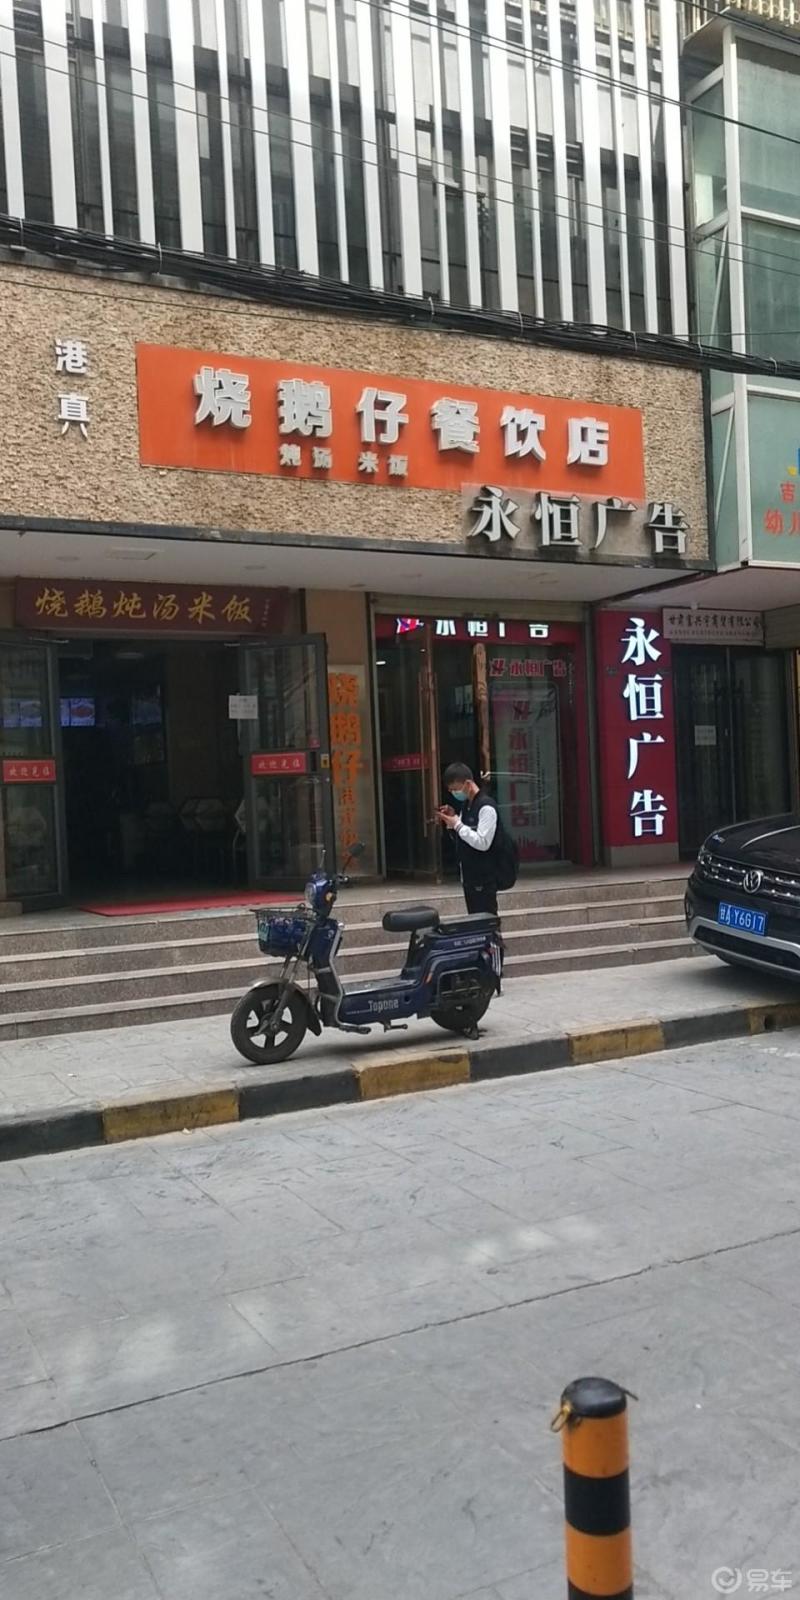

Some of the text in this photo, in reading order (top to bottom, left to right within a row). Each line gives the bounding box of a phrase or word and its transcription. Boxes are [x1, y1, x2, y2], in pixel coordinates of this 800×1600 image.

[54, 338, 90, 438] 港真
[194, 366, 610, 467] 烧鹅仔餐饮店
[467, 485, 690, 554] 永恒广告
[35, 587, 253, 624] 烧鹅炖汤米饭
[621, 617, 668, 838] 永恒广告
